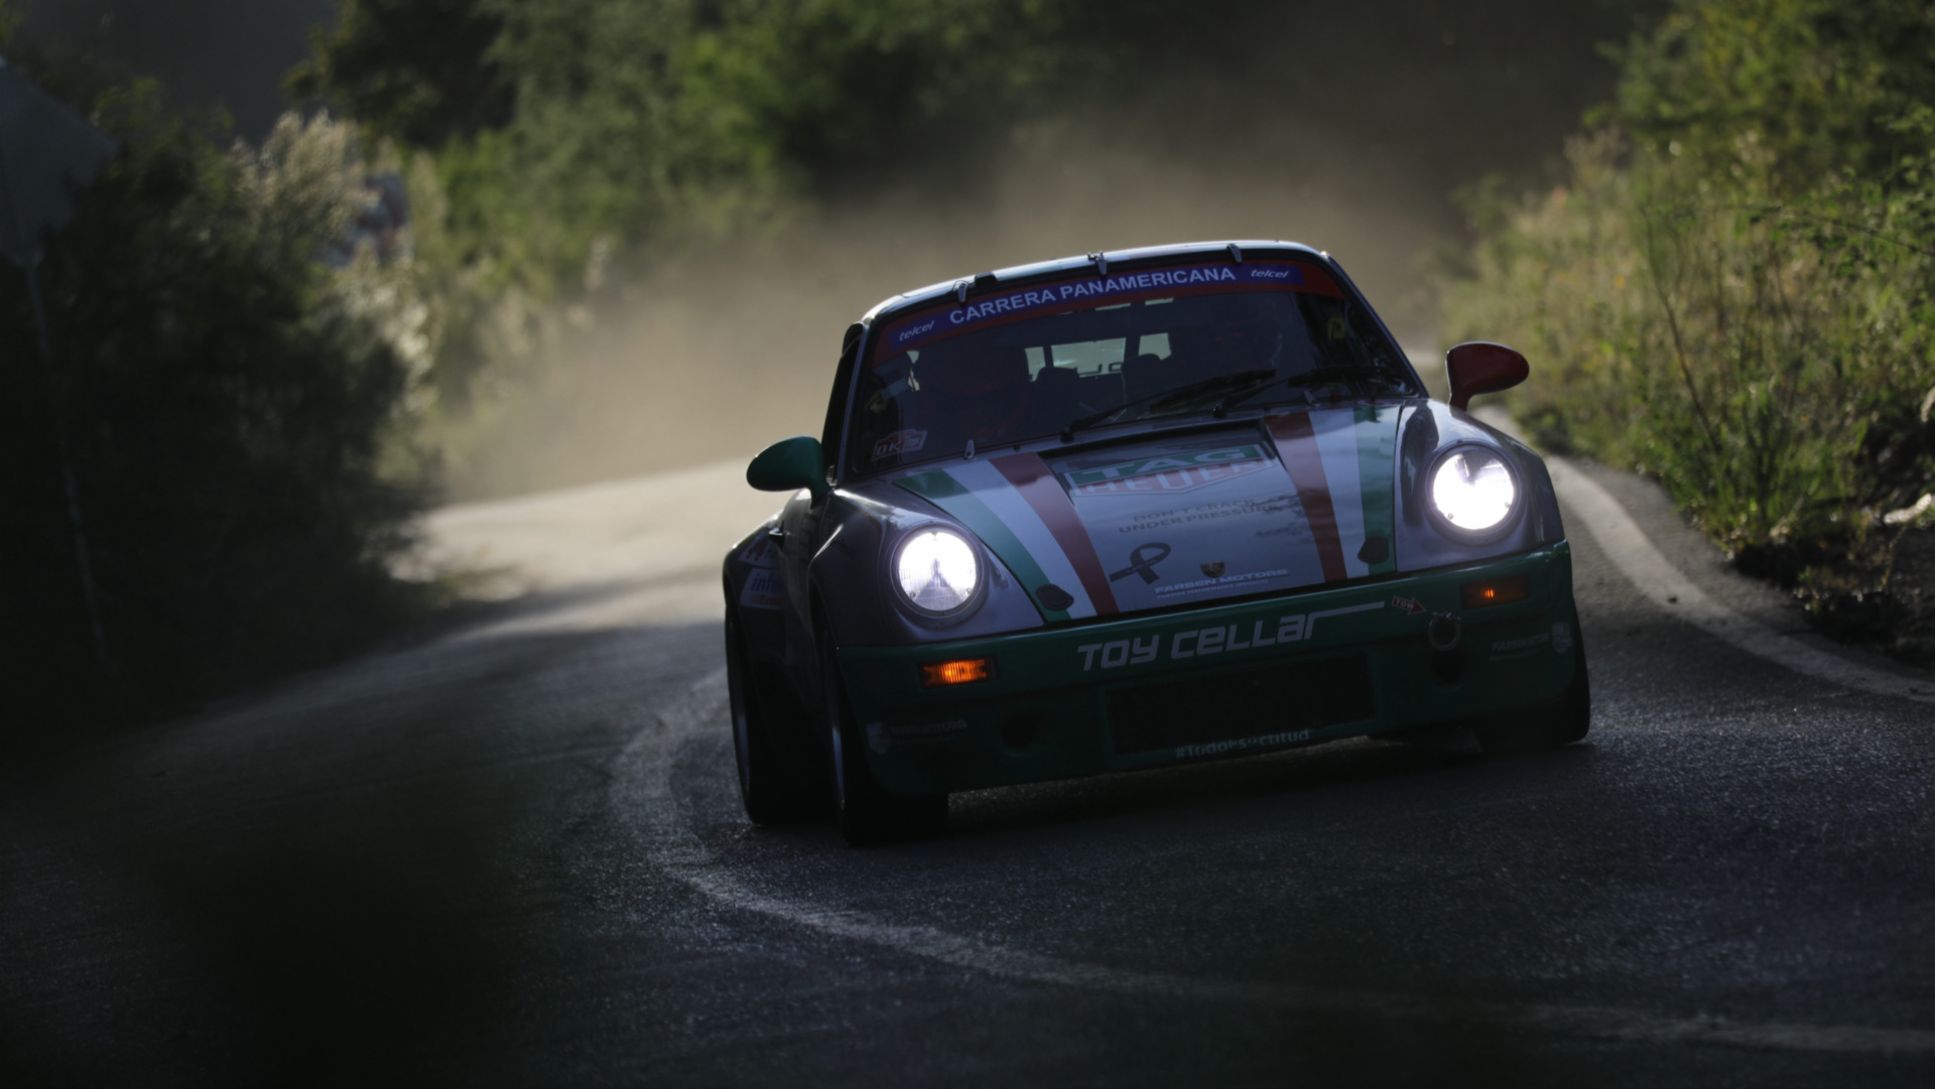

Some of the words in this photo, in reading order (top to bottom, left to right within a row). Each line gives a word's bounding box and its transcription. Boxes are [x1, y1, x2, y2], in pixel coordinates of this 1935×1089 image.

[898, 319, 935, 342] telcel
[949, 289, 1056, 325] CARRERA
[1060, 267, 1236, 299] PANAMERICANA
[1250, 268, 1289, 280] telcel
[1079, 449, 1246, 478] TAG
[1118, 517, 1183, 533] UNDER
[1219, 568, 1289, 585] MOTORS
[1077, 631, 1161, 672] TOY
